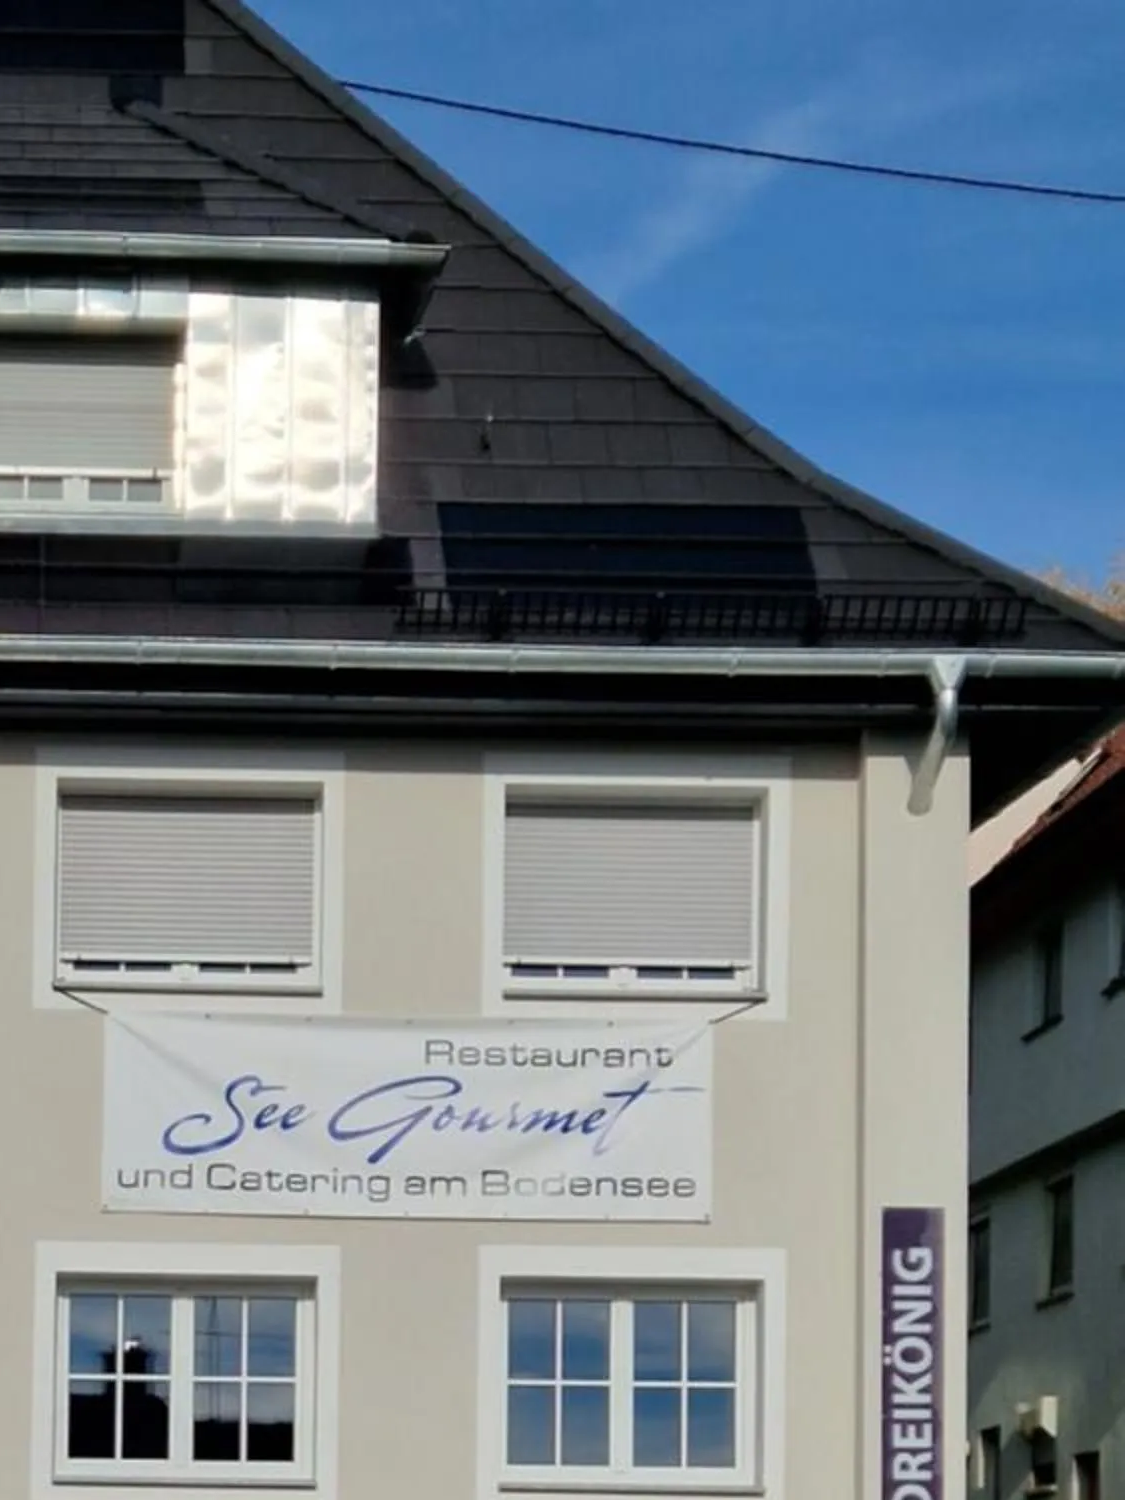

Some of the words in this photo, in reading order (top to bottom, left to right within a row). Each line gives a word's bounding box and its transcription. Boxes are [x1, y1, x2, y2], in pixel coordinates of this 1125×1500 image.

[424, 1039, 675, 1069] Restaurant
[162, 1075, 313, 1155] See
[327, 1075, 705, 1164] Gourmet
[116, 1163, 194, 1190] und
[206, 1164, 391, 1202] Catering
[403, 1176, 467, 1197] am
[480, 1170, 697, 1199] Bodensee
